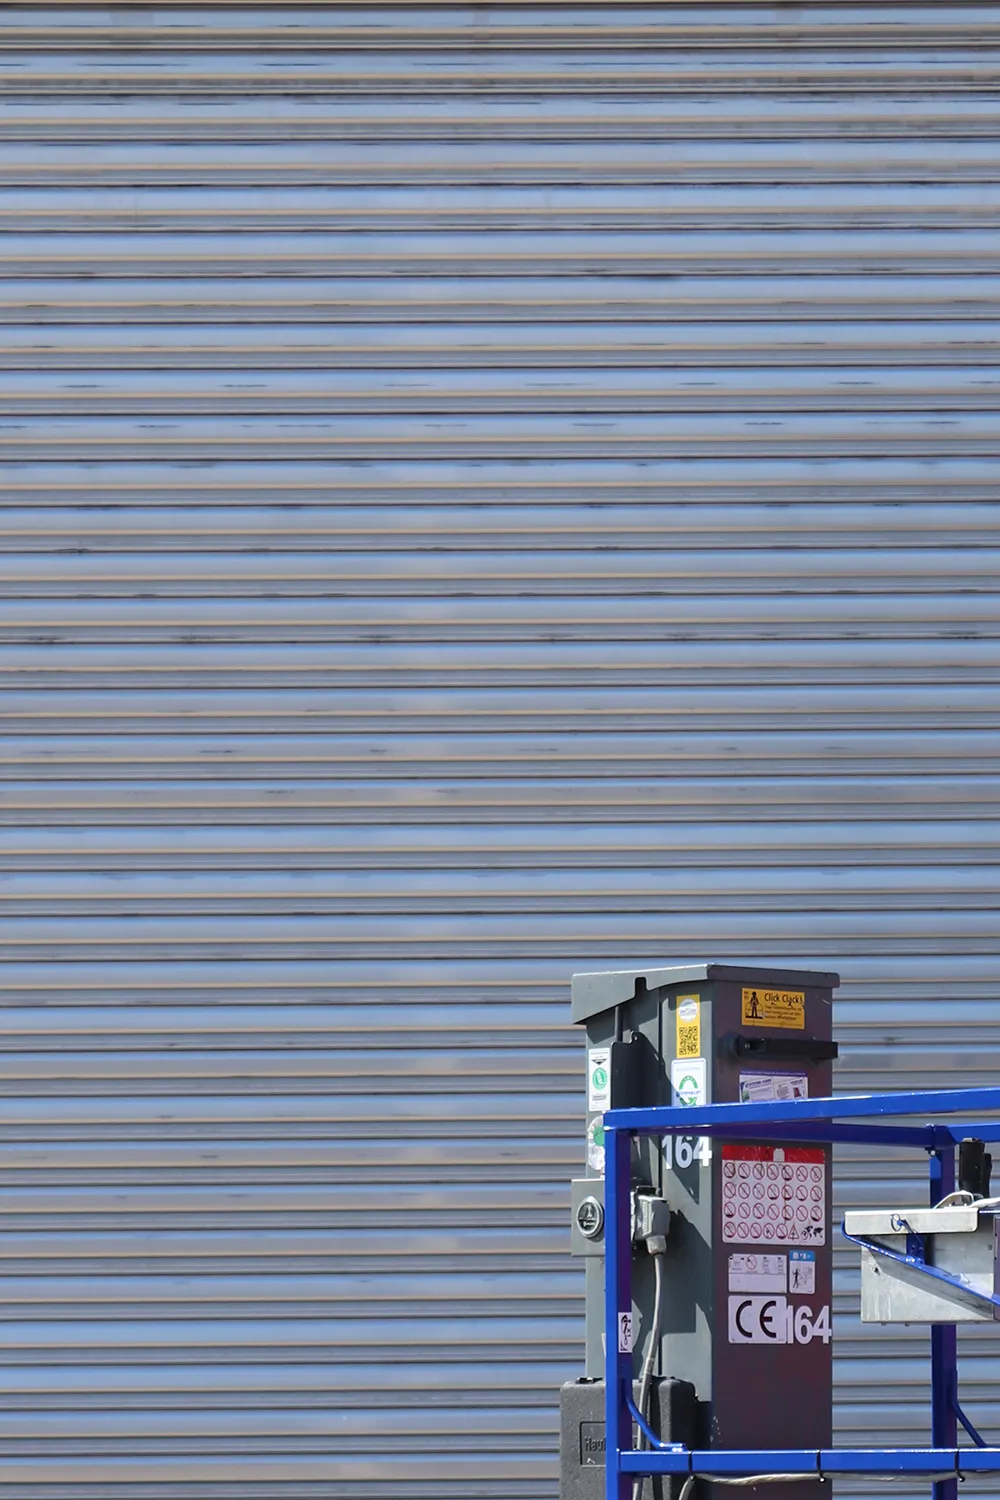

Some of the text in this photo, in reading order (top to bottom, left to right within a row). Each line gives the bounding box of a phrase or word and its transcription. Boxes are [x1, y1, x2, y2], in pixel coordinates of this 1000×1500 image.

[764, 993, 781, 1003] Click
[661, 1135, 713, 1170] 164
[735, 1300, 777, 1339] CE
[786, 1304, 833, 1345] 164
